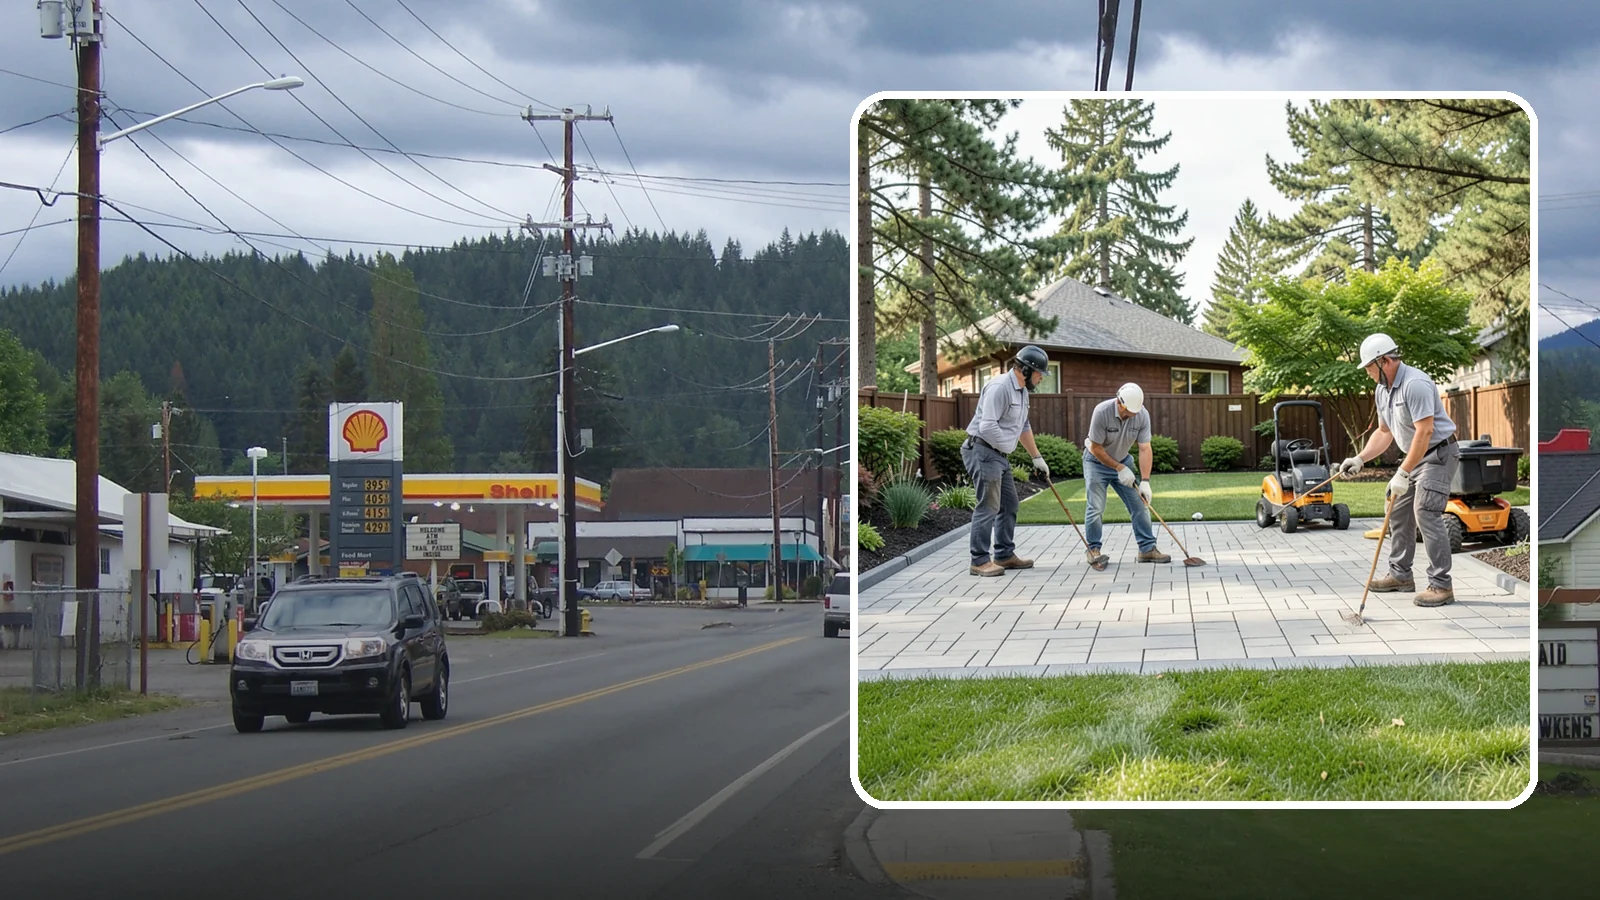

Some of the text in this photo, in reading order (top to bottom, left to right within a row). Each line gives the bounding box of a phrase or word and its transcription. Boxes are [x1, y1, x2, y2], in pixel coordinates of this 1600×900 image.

[366, 480, 383, 490] 395
[490, 484, 547, 499] Shell
[366, 494, 383, 504] 405
[366, 508, 383, 518] 415
[366, 522, 383, 532] 429
[1538, 643, 1567, 666] AID
[1539, 715, 1592, 739] WKENS
